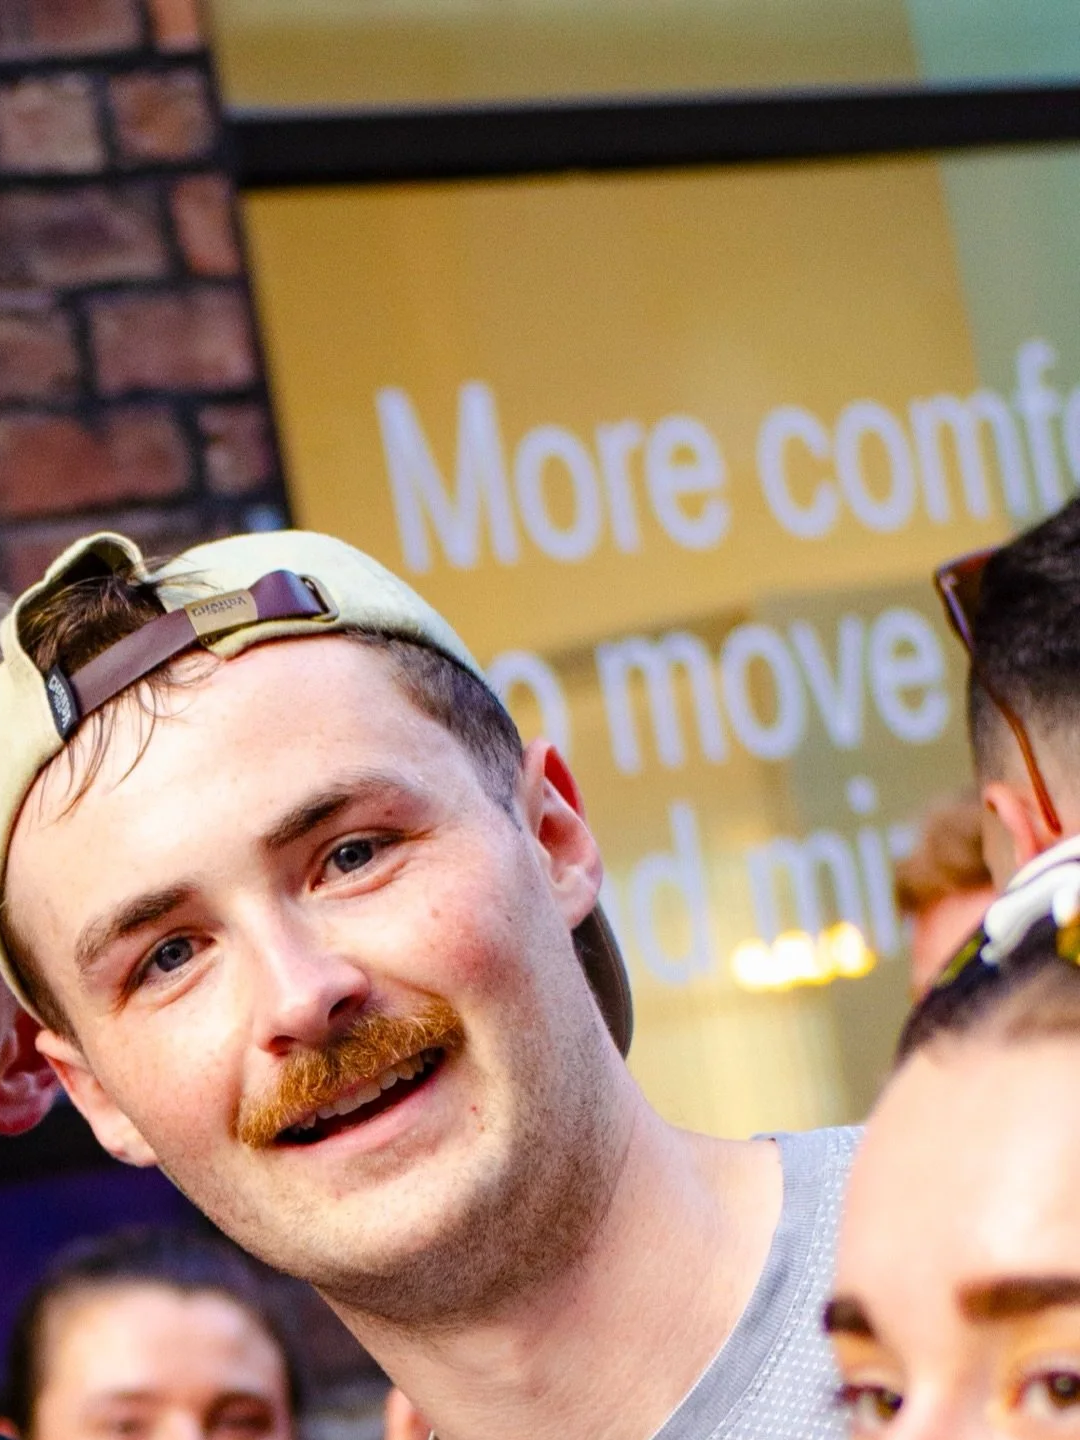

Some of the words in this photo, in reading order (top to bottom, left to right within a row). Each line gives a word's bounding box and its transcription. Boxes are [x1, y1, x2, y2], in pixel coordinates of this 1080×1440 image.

[375, 381, 730, 573] More
[596, 607, 950, 773] move
[745, 776, 916, 957] mi
